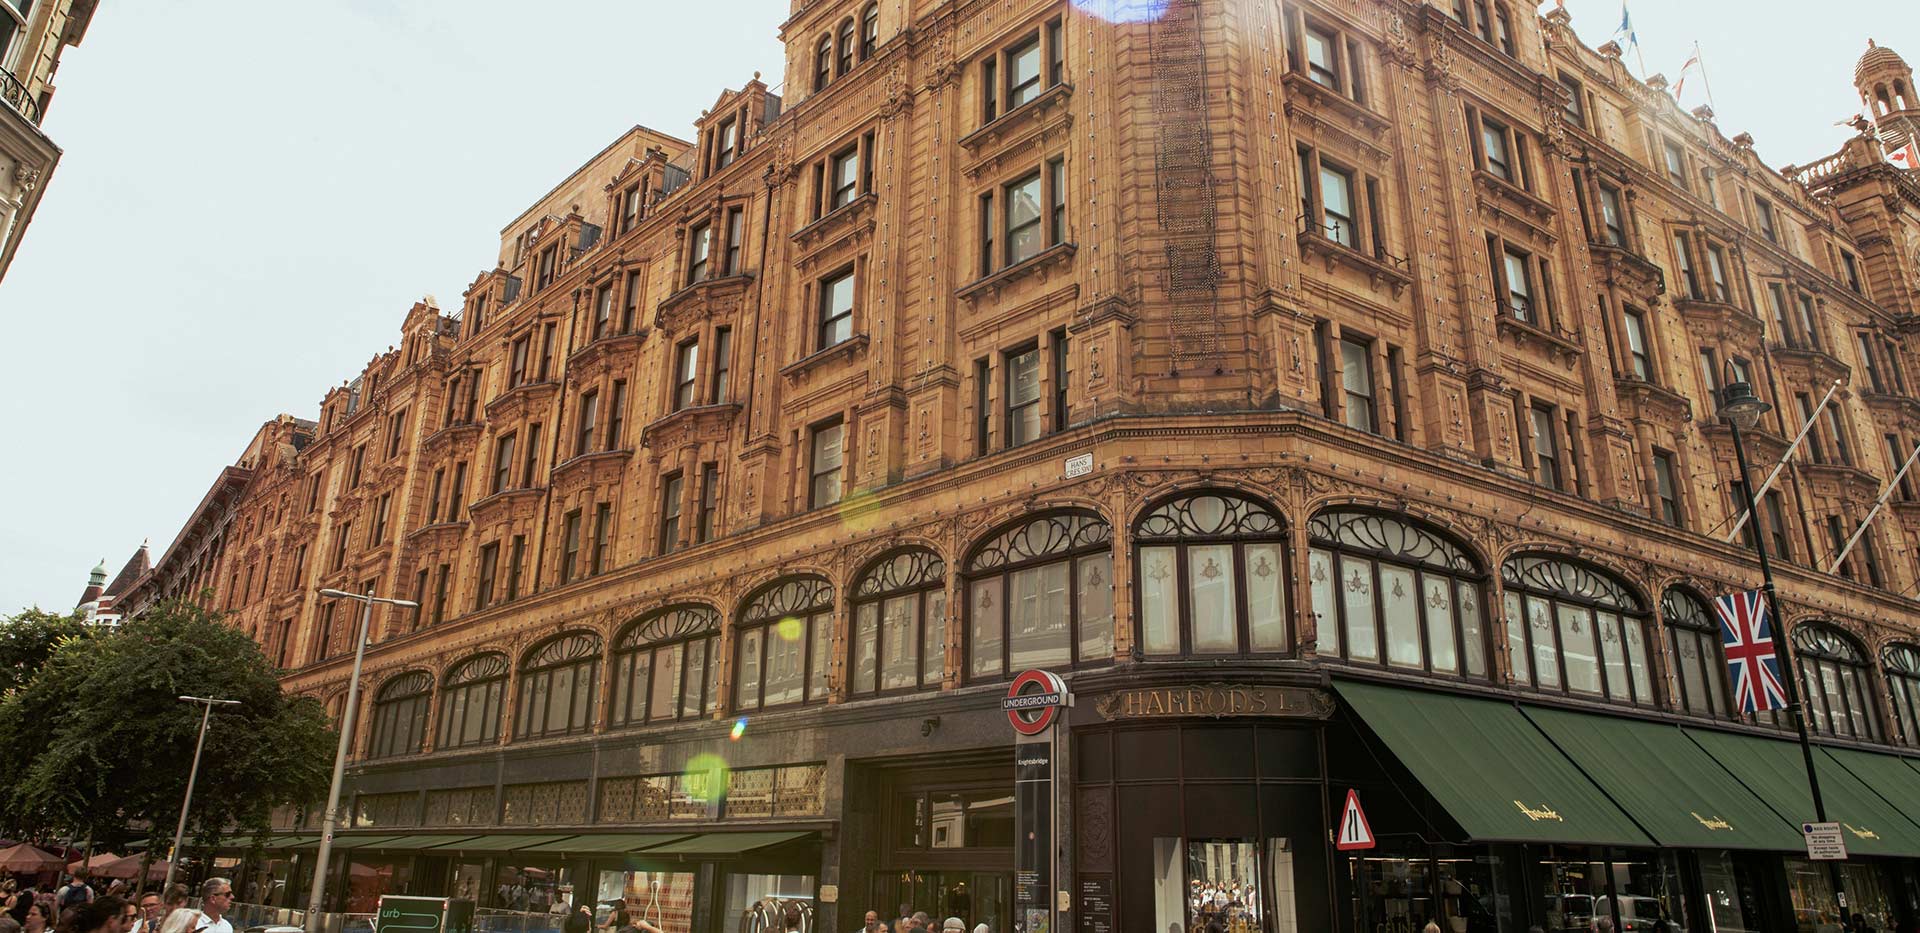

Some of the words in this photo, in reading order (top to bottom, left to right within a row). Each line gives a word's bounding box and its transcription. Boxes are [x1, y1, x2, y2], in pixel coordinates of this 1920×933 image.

[1150, 0, 1220, 362] ARRODS
[1070, 458, 1088, 469] HANS
[1003, 695, 1059, 708] UNDERGROUND
[1127, 689, 1268, 715] HARRODS
[1017, 758, 1049, 767] Knightsbridge
[382, 907, 401, 919] urb
